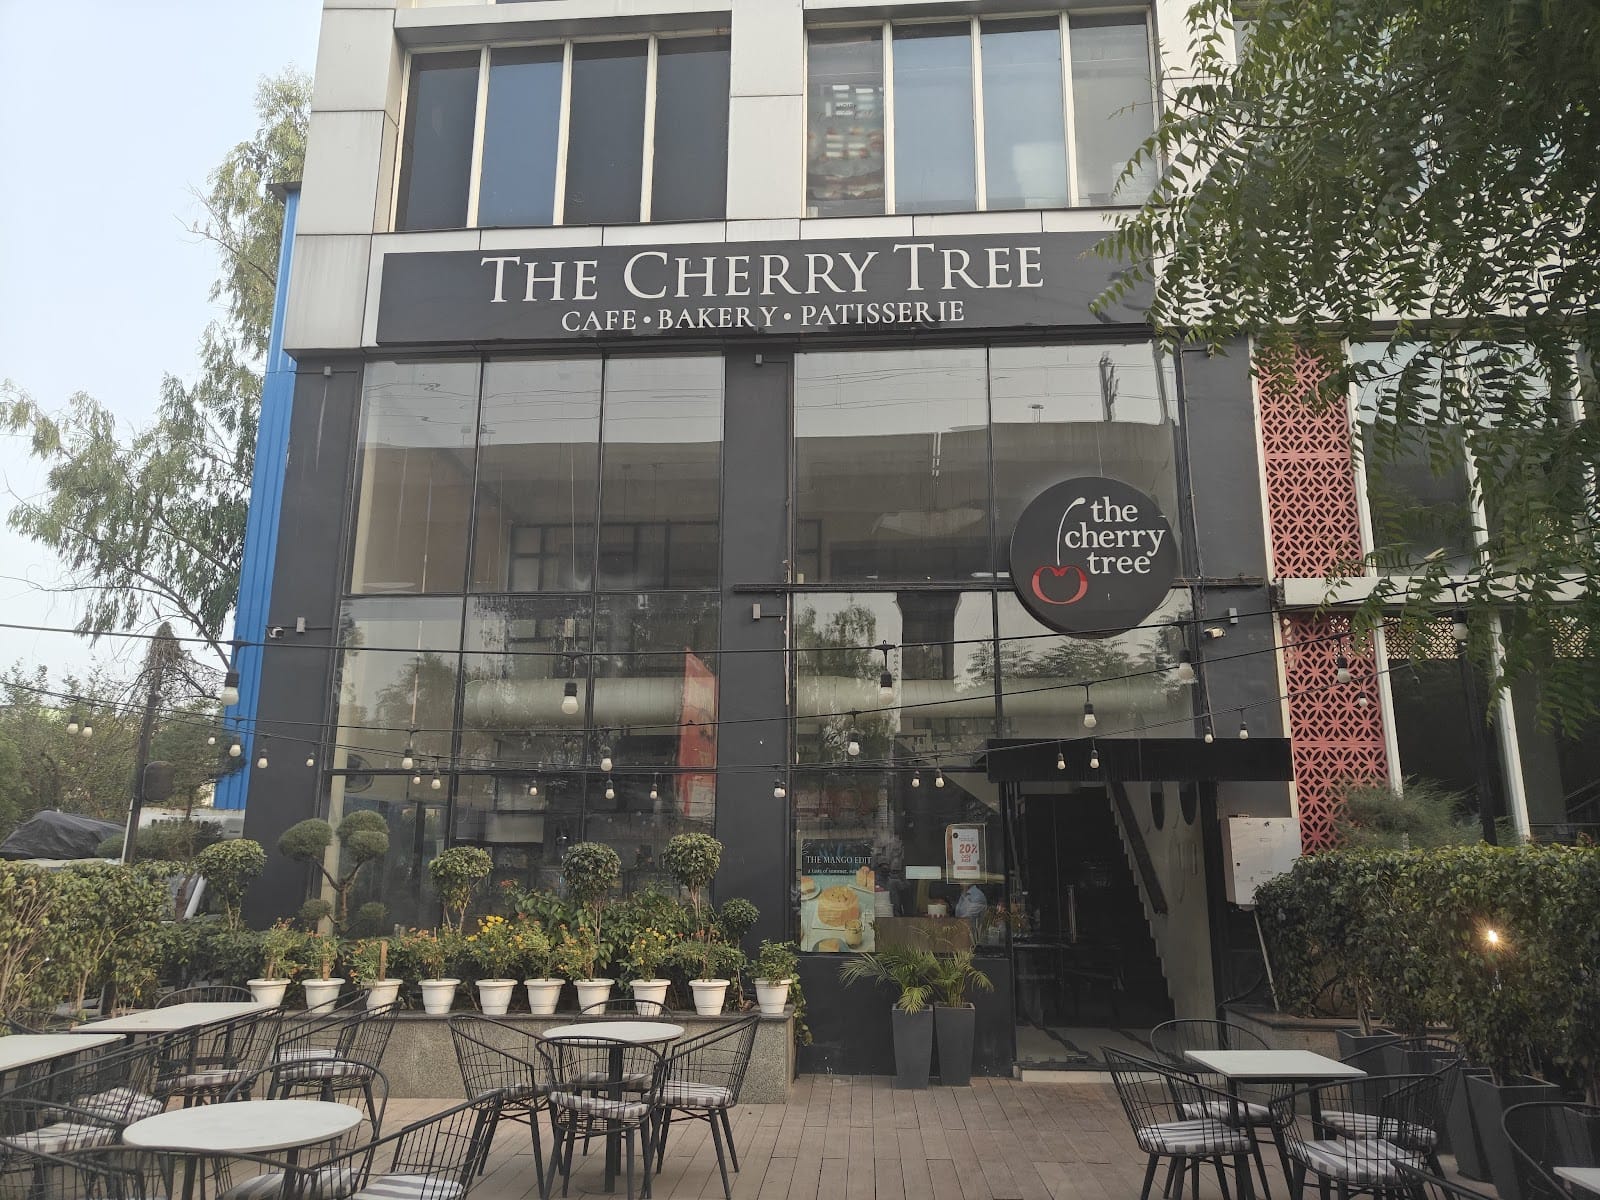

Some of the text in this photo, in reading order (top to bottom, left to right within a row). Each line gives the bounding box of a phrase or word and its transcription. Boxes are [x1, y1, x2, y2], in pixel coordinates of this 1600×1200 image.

[480, 243, 1045, 302] THE CHERRY TREE
[561, 300, 966, 332] CAFE BAKERY PATISSERIE
[1089, 496, 1138, 523] the
[1064, 521, 1166, 557] cherry
[1086, 551, 1151, 575] tree
[806, 855, 873, 864] THE MANGO EDIT
[959, 843, 978, 854] 20%
